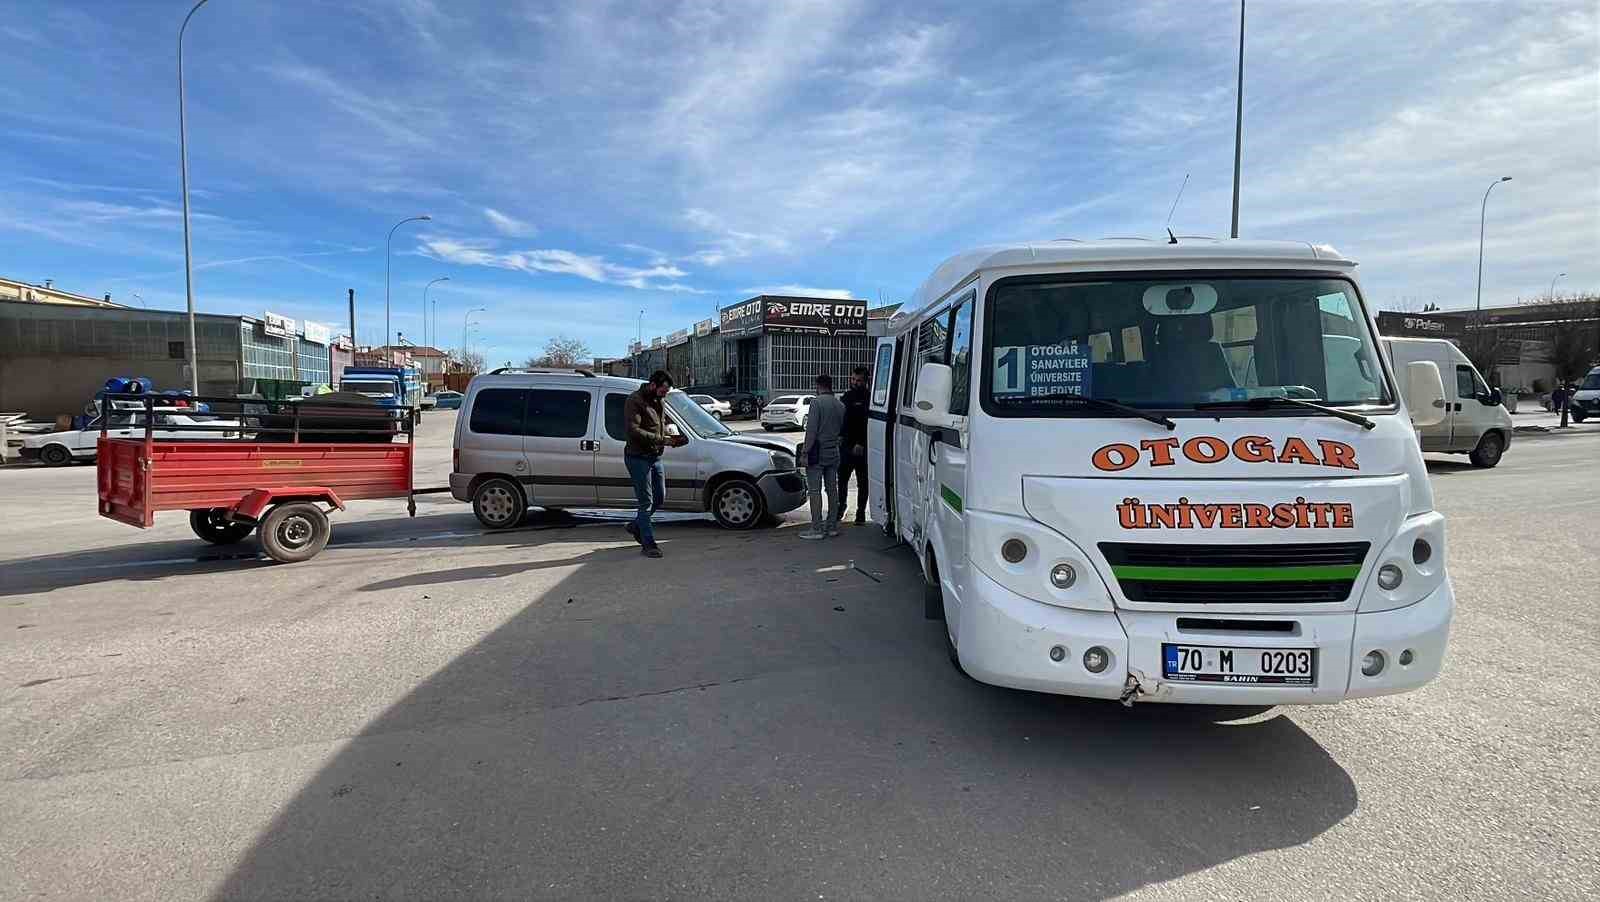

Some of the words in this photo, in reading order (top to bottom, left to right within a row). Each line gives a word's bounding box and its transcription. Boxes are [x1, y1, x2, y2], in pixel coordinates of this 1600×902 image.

[746, 300, 761, 316] OTO
[790, 303, 832, 318] EMRE
[834, 305, 865, 318] OTO
[1031, 345, 1078, 356] OTOGAR
[998, 348, 1018, 388] 1
[1091, 435, 1360, 472] OTOGAR
[1116, 496, 1354, 529] ÜNİVERSİTE
[1167, 660, 1177, 668] TR
[1178, 648, 1203, 671] 70
[1219, 650, 1234, 673] M
[1261, 652, 1309, 674] 0203
